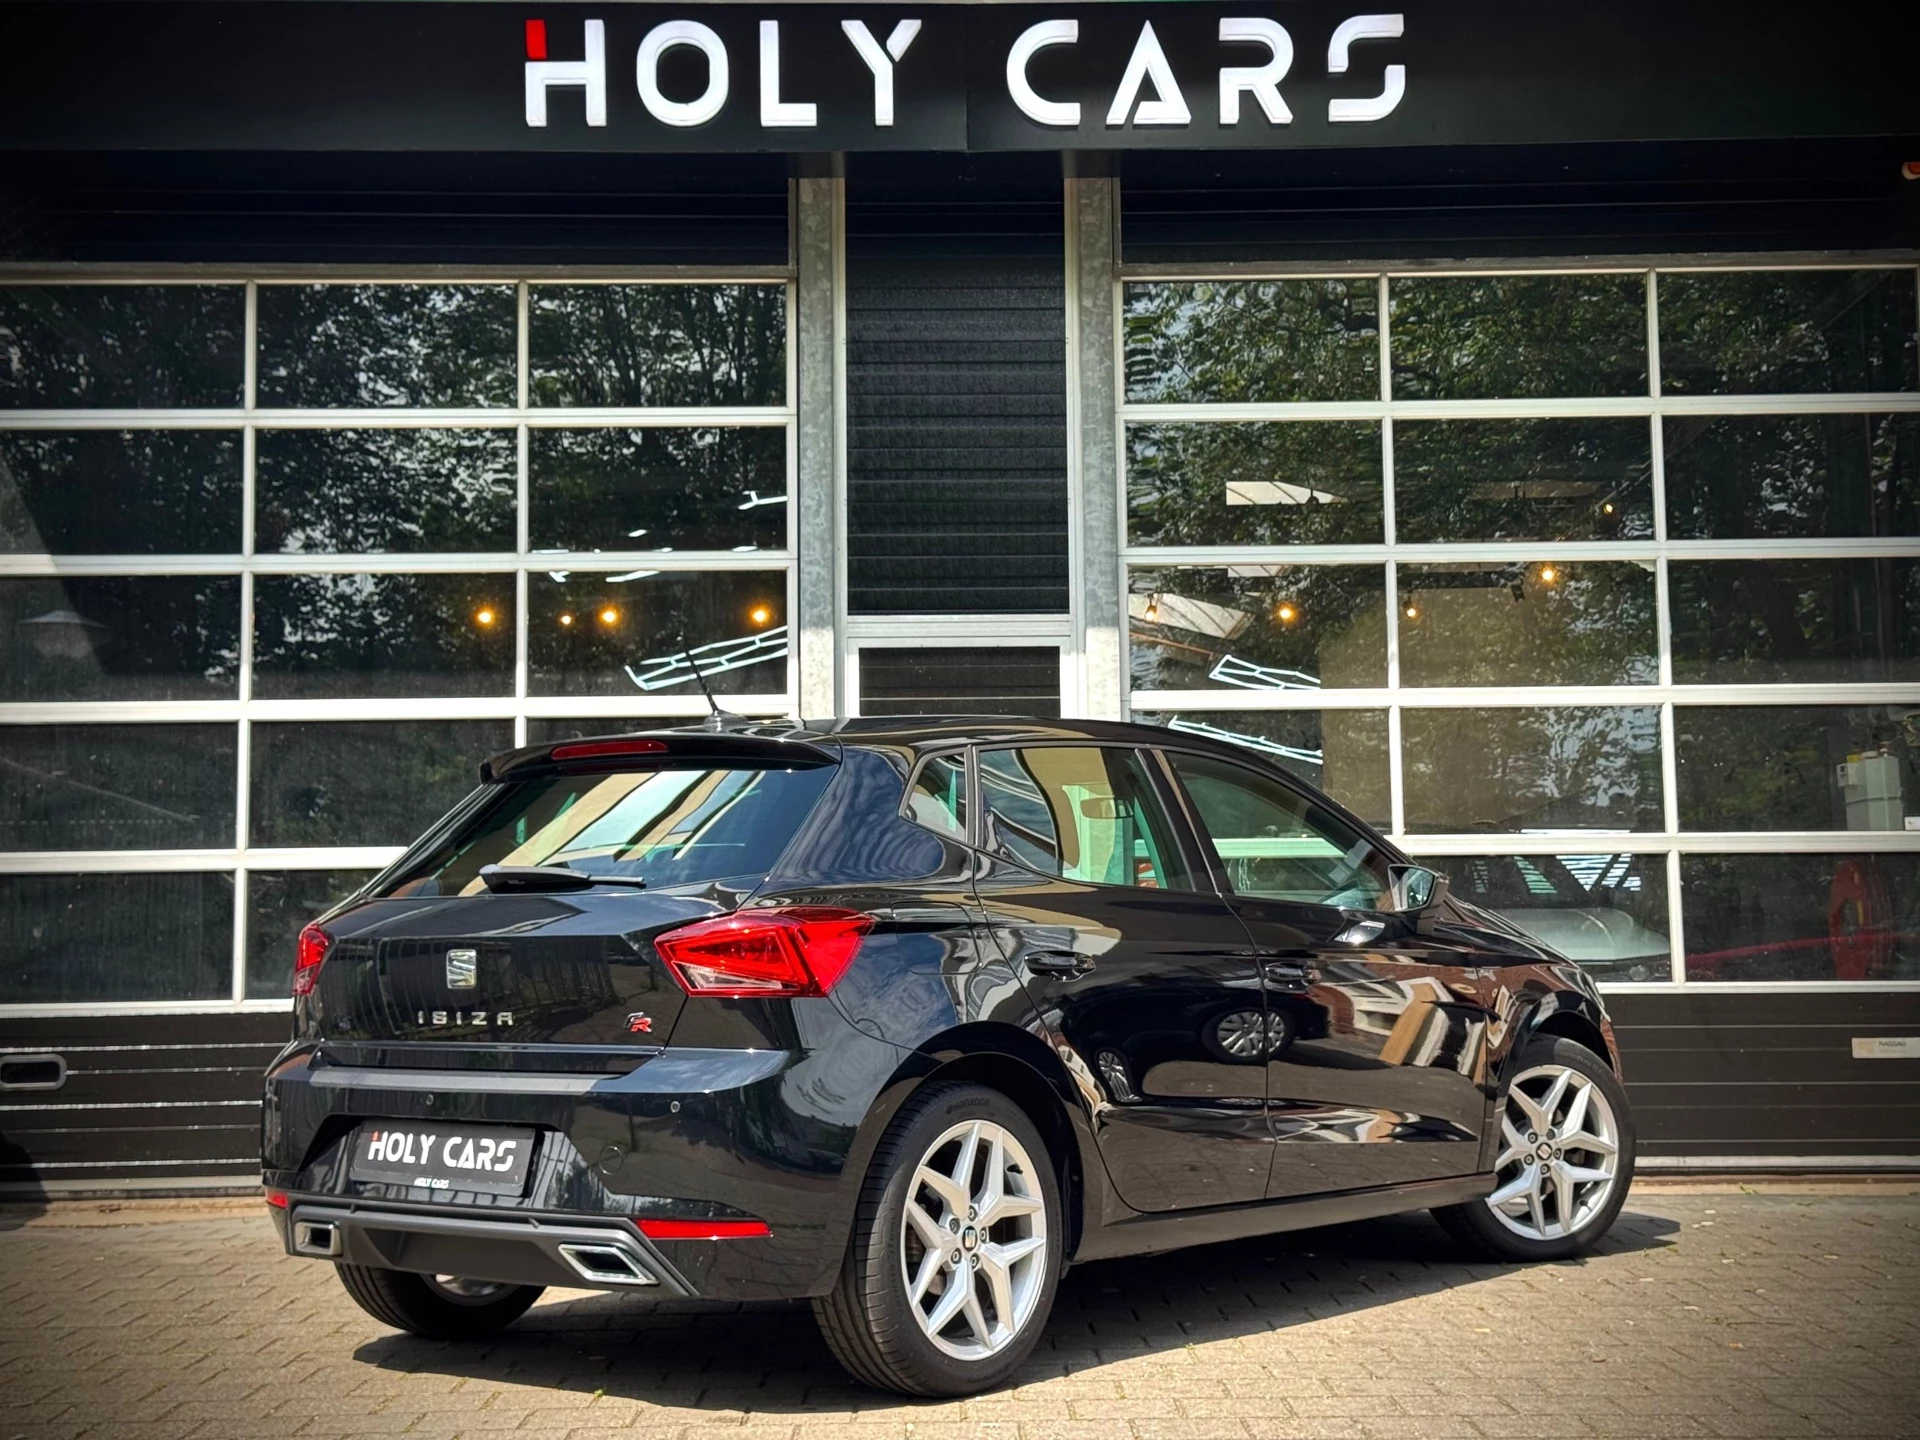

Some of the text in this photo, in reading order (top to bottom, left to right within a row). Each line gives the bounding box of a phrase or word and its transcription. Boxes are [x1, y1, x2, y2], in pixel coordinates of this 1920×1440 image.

[525, 13, 1407, 127] HOLY CARS
[417, 1010, 514, 1026] IBIZA
[367, 1130, 518, 1172] HOLY CARS
